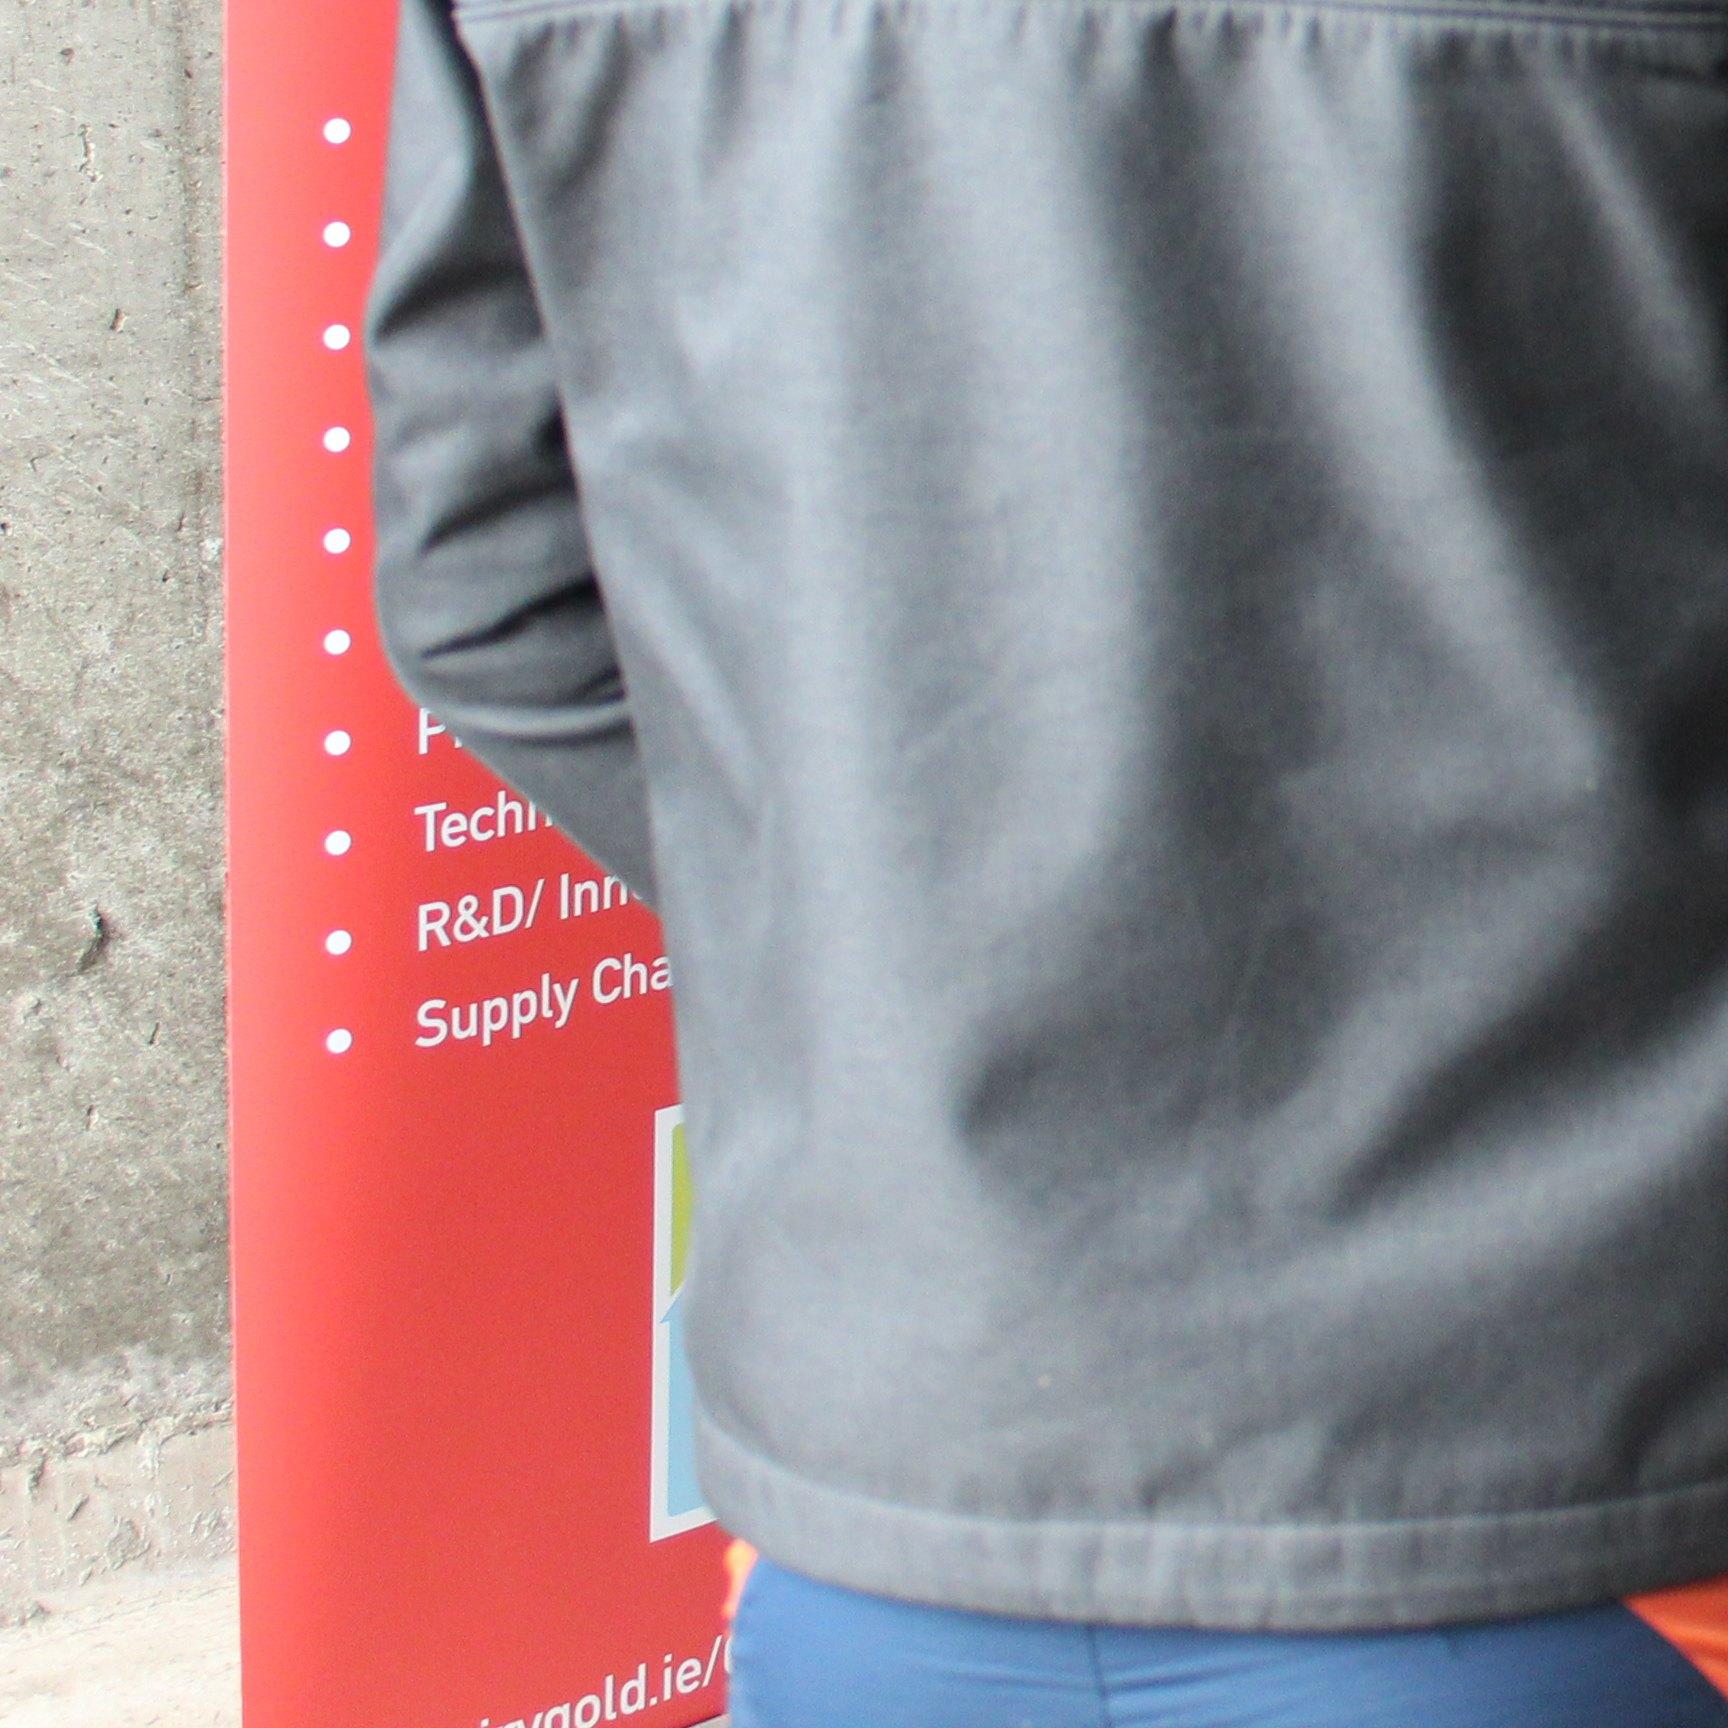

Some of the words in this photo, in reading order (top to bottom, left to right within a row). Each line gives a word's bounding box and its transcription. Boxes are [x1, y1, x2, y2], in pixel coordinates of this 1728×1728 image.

[417, 876, 546, 953] R&D/
[559, 871, 644, 921] Inn
[414, 973, 580, 1049] Supply
